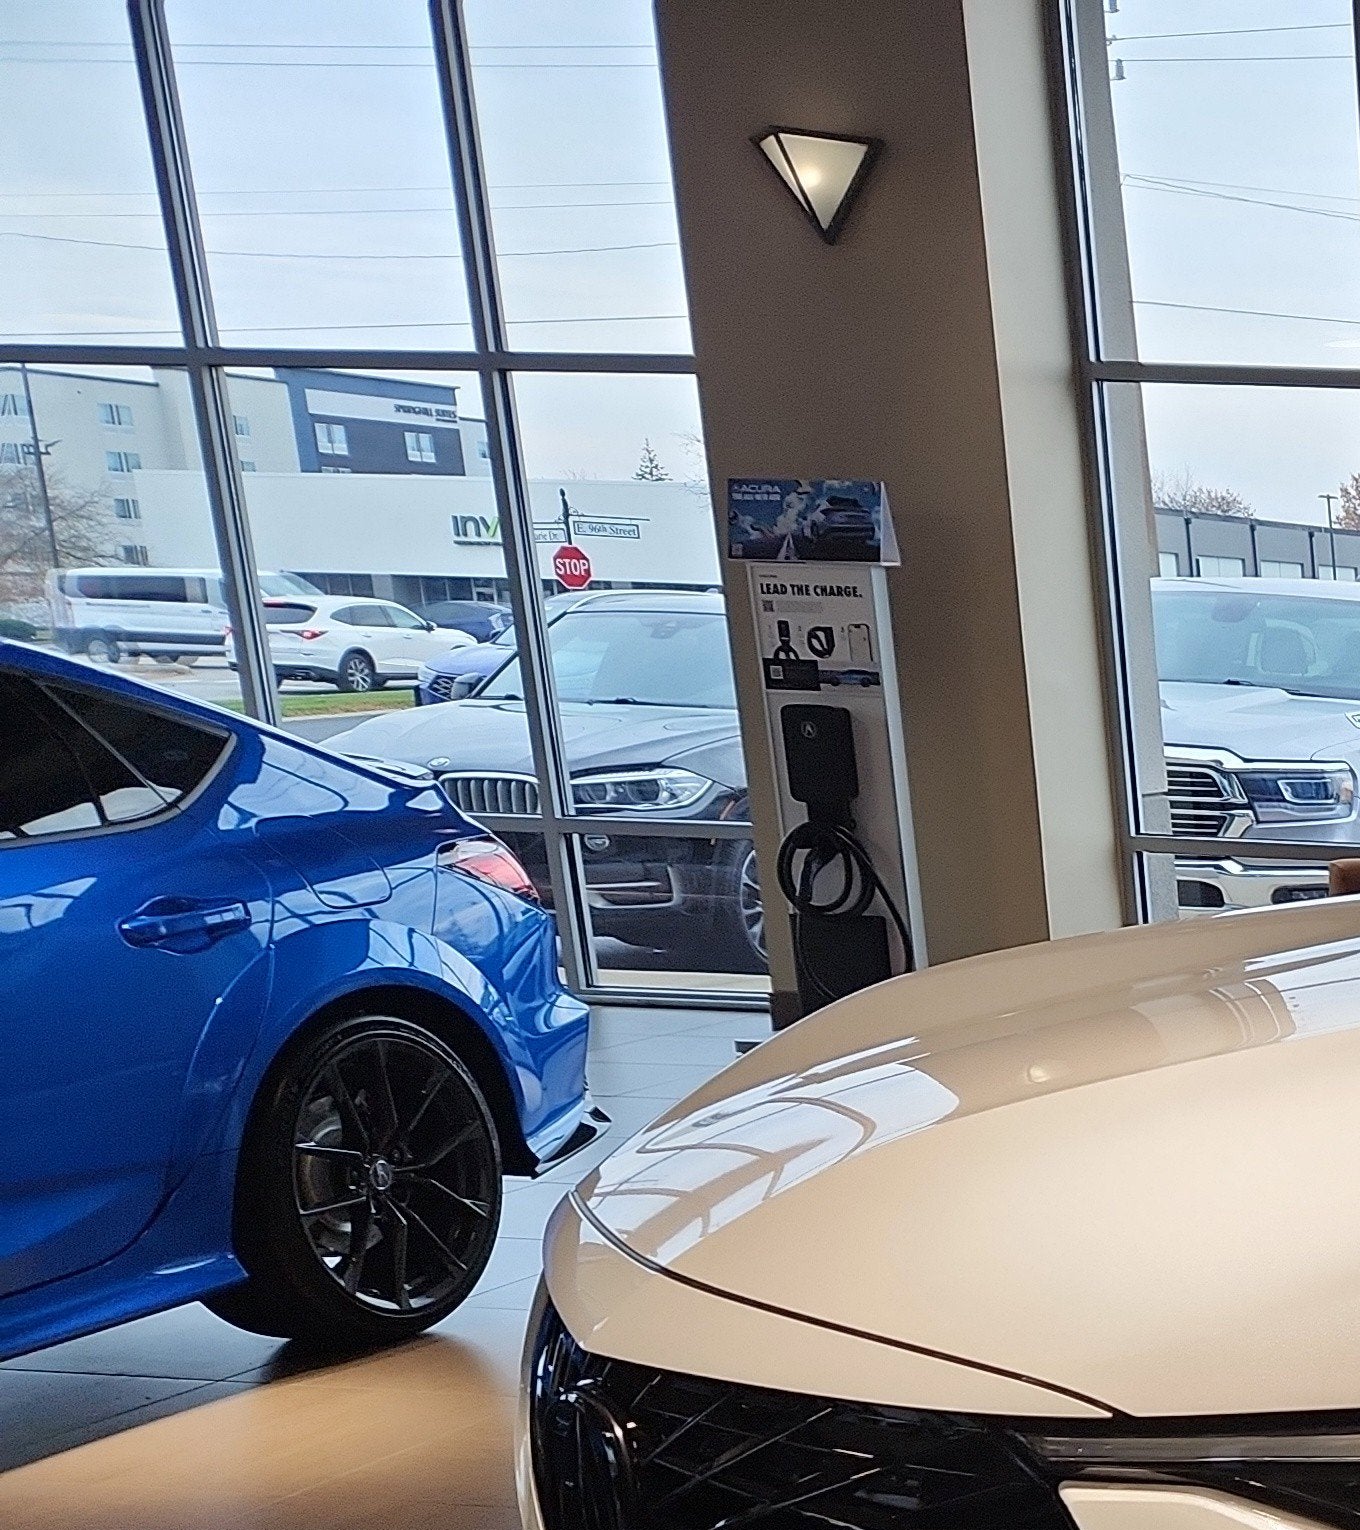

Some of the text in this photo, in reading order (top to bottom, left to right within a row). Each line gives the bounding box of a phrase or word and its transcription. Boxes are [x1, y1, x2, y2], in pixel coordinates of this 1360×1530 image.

[588, 524, 607, 535] 96th
[609, 525, 637, 537] Street
[555, 558, 589, 576] STOP
[760, 583, 863, 598] LEAD THE CHARGE.
